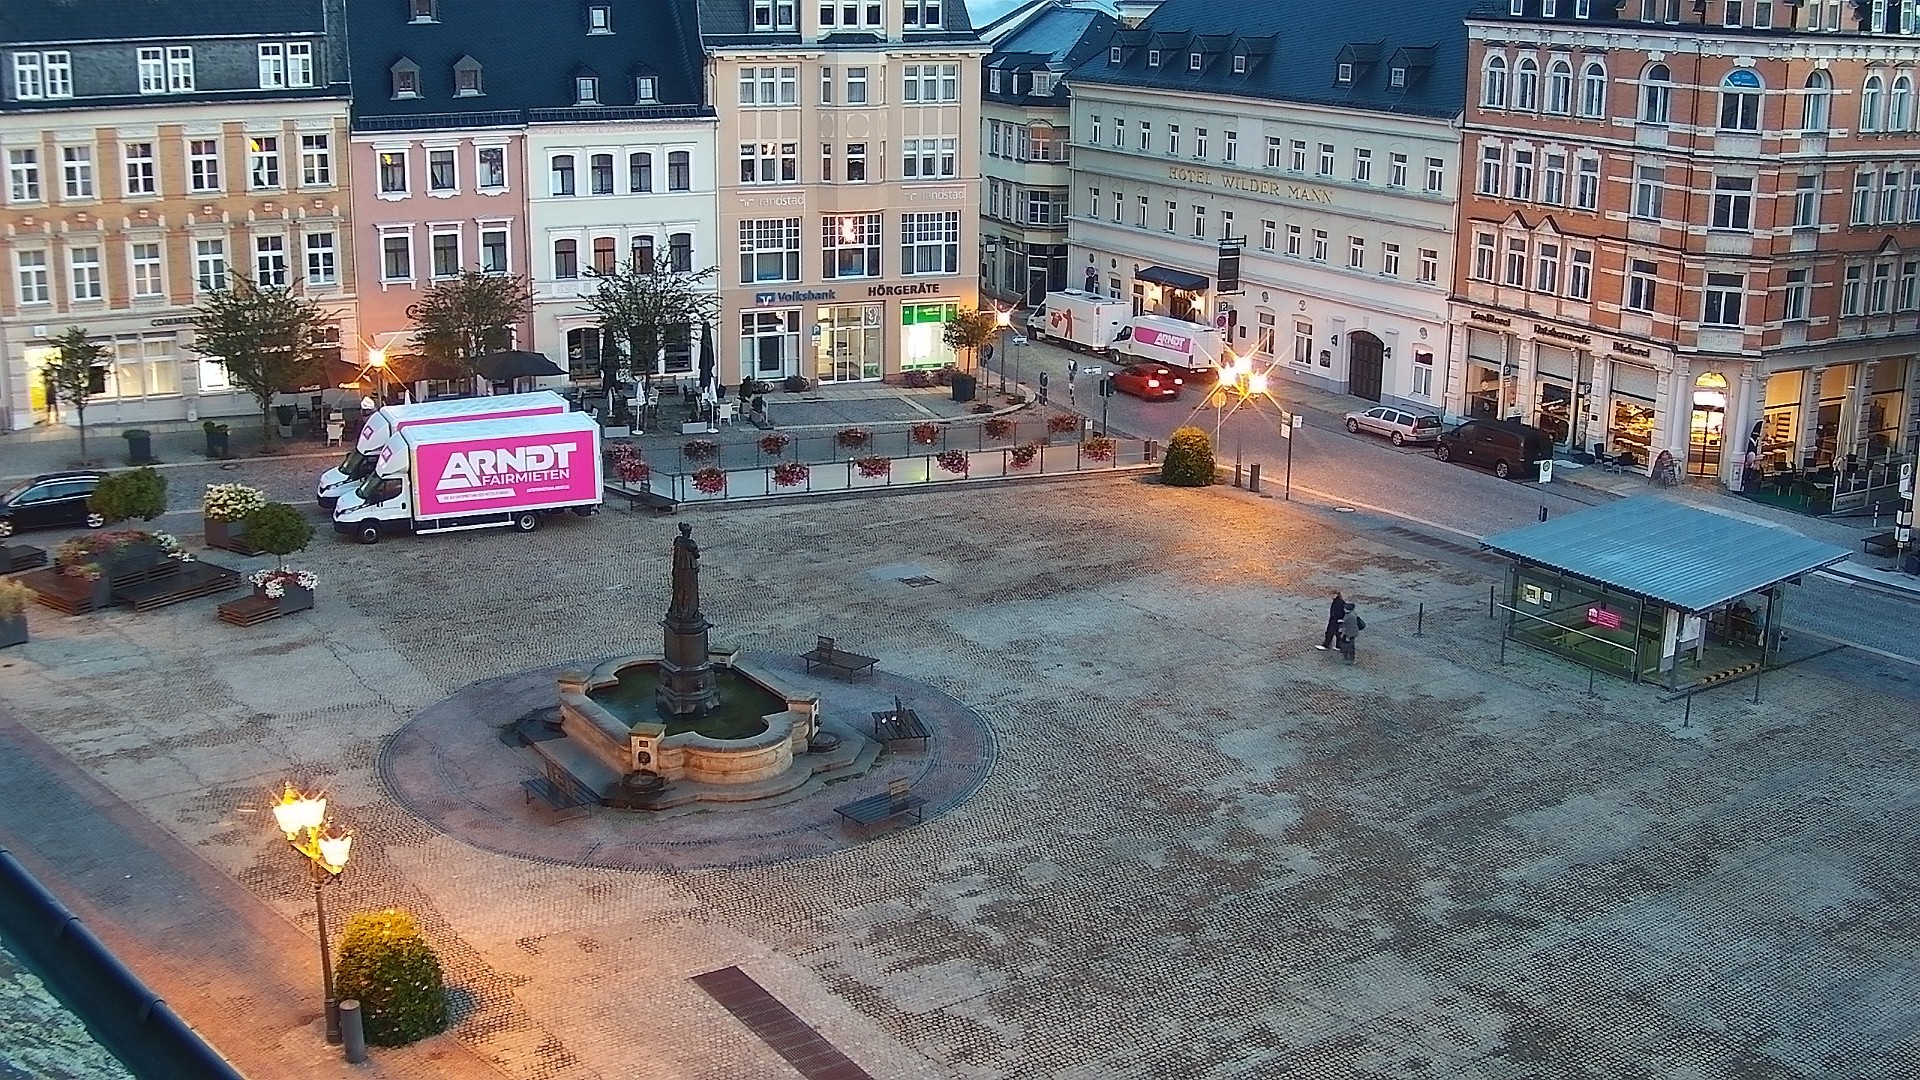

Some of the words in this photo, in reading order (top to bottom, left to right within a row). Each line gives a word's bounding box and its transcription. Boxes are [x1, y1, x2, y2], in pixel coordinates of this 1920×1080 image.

[1169, 167, 1212, 185] HOTEL
[1222, 175, 1280, 197] WILDER
[1288, 186, 1333, 205] MANN
[777, 289, 836, 302] Volksbank
[868, 283, 940, 297] HÖRGERÄTE
[1153, 332, 1186, 347] ARNDT
[435, 442, 577, 490] ARNDT
[482, 468, 570, 486] FAIRMIETEN
